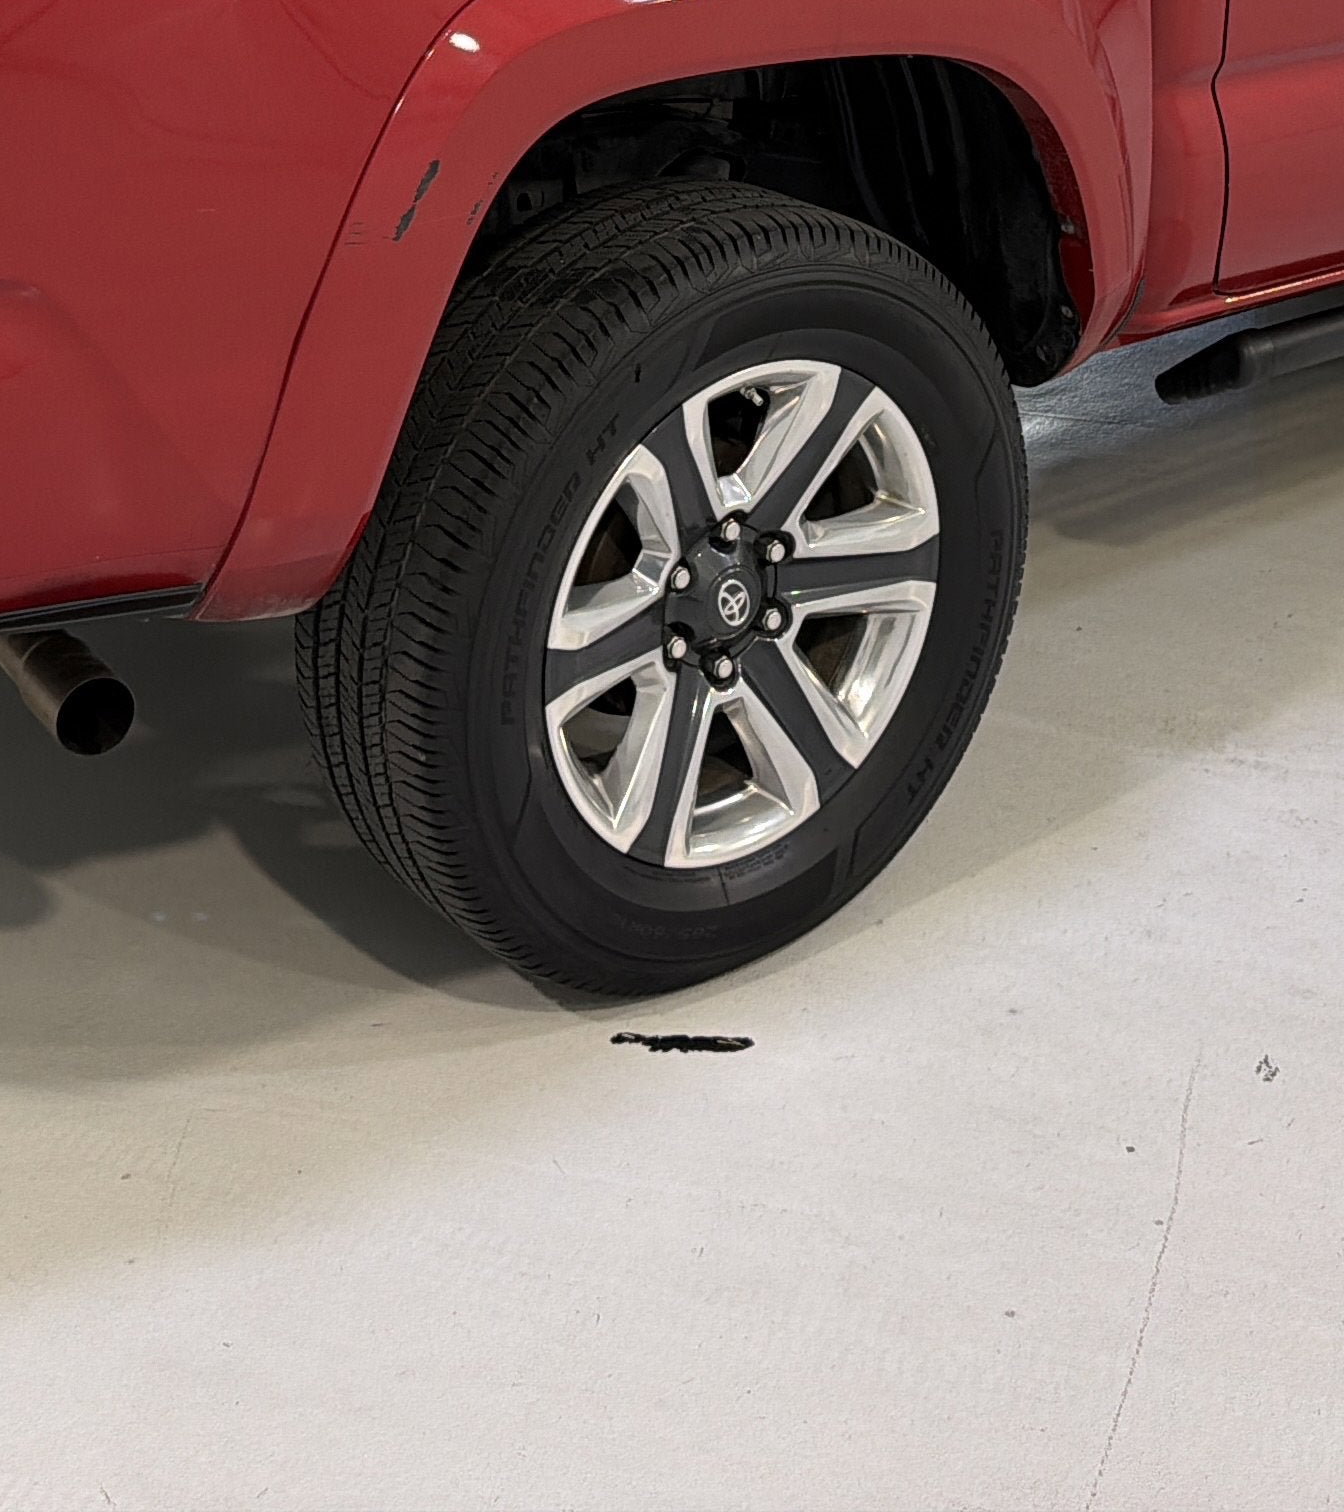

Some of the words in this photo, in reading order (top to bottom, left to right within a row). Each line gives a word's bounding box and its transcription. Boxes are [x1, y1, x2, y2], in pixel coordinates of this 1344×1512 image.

[501, 471, 582, 726] PATHFINDER
[585, 411, 621, 467] HT
[937, 529, 1004, 754] PATHFINDER
[905, 758, 935, 804] HT
